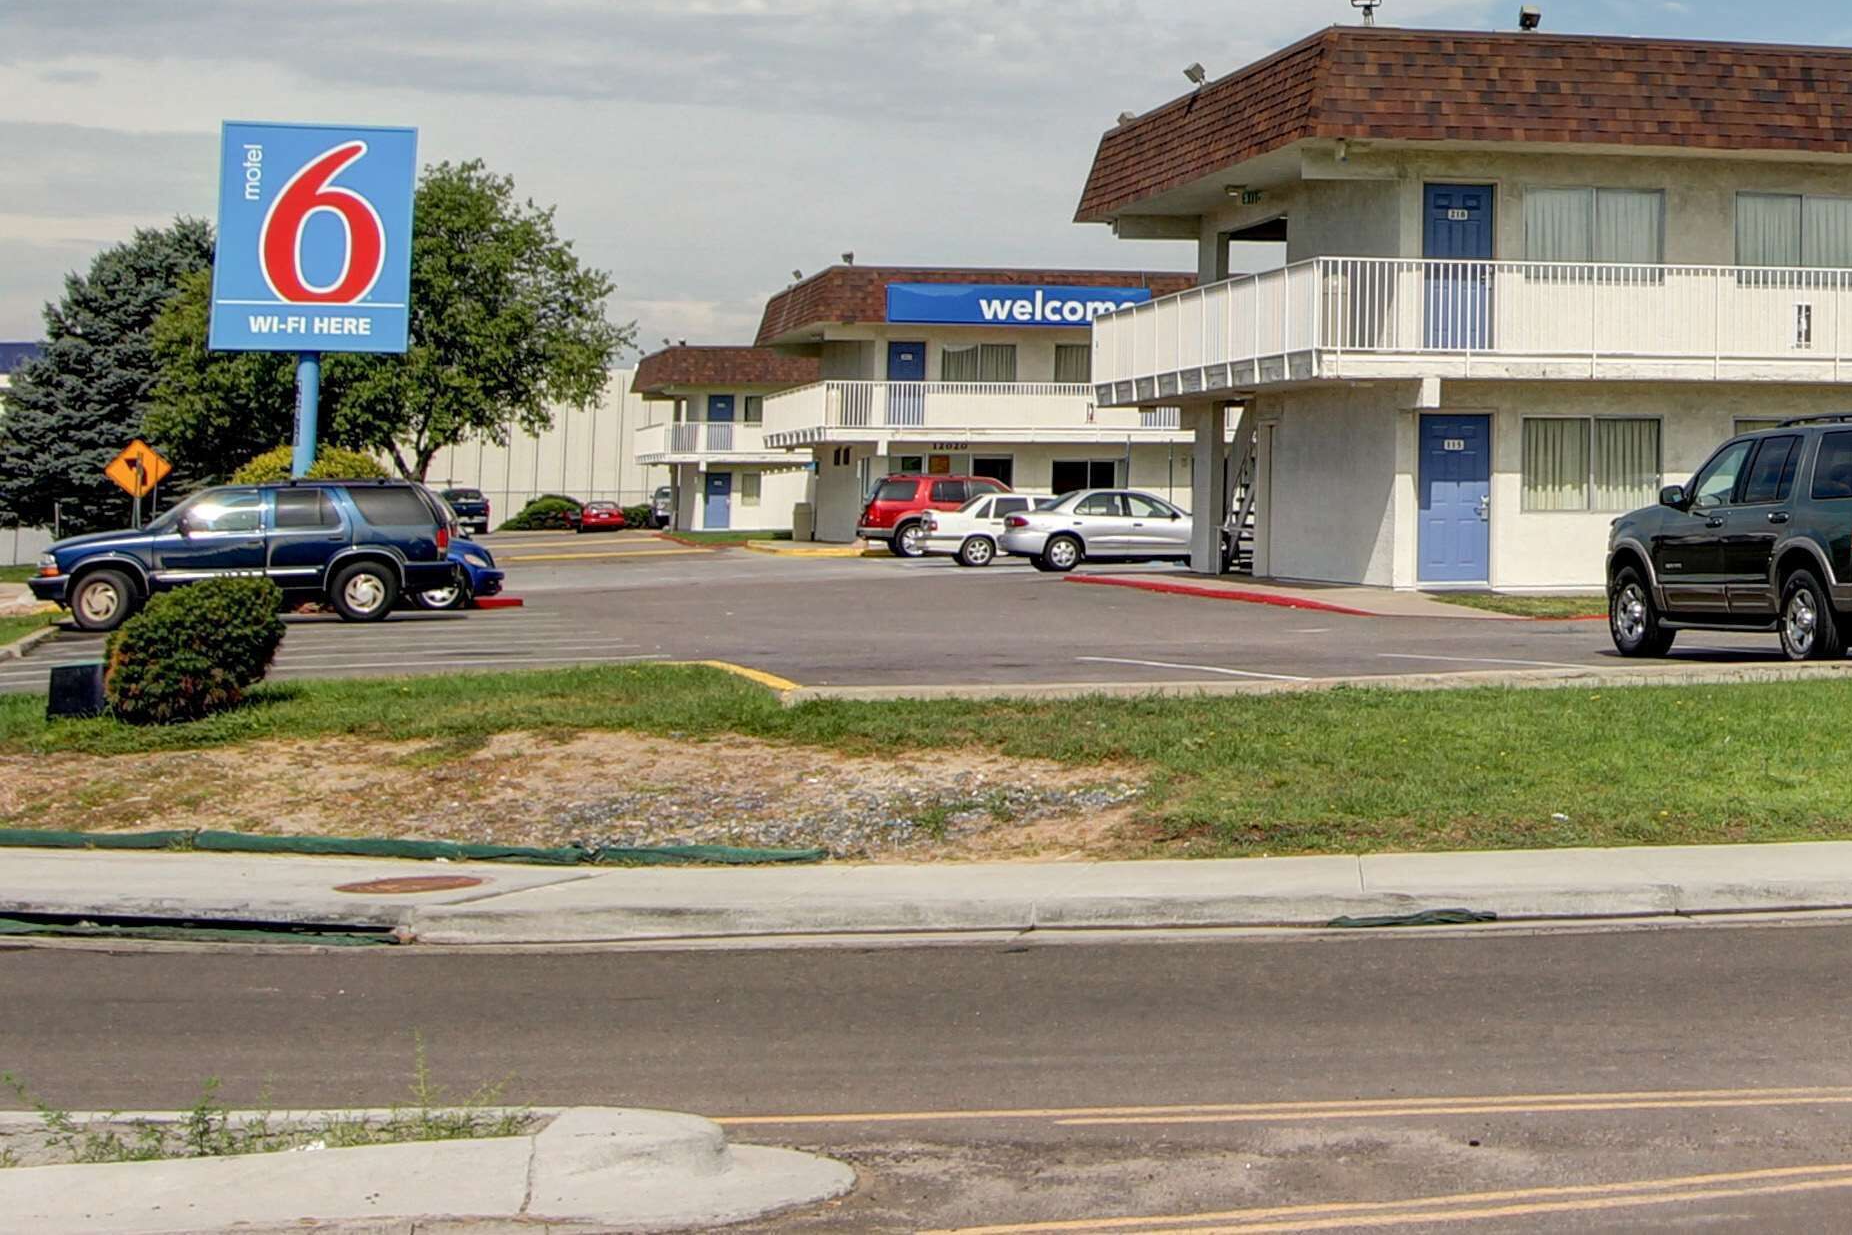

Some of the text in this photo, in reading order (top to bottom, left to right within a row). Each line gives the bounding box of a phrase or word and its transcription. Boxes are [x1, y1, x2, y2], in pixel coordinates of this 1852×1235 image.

[242, 144, 263, 201] motel
[258, 140, 386, 305] 6
[249, 316, 372, 336] WI-FI HERE
